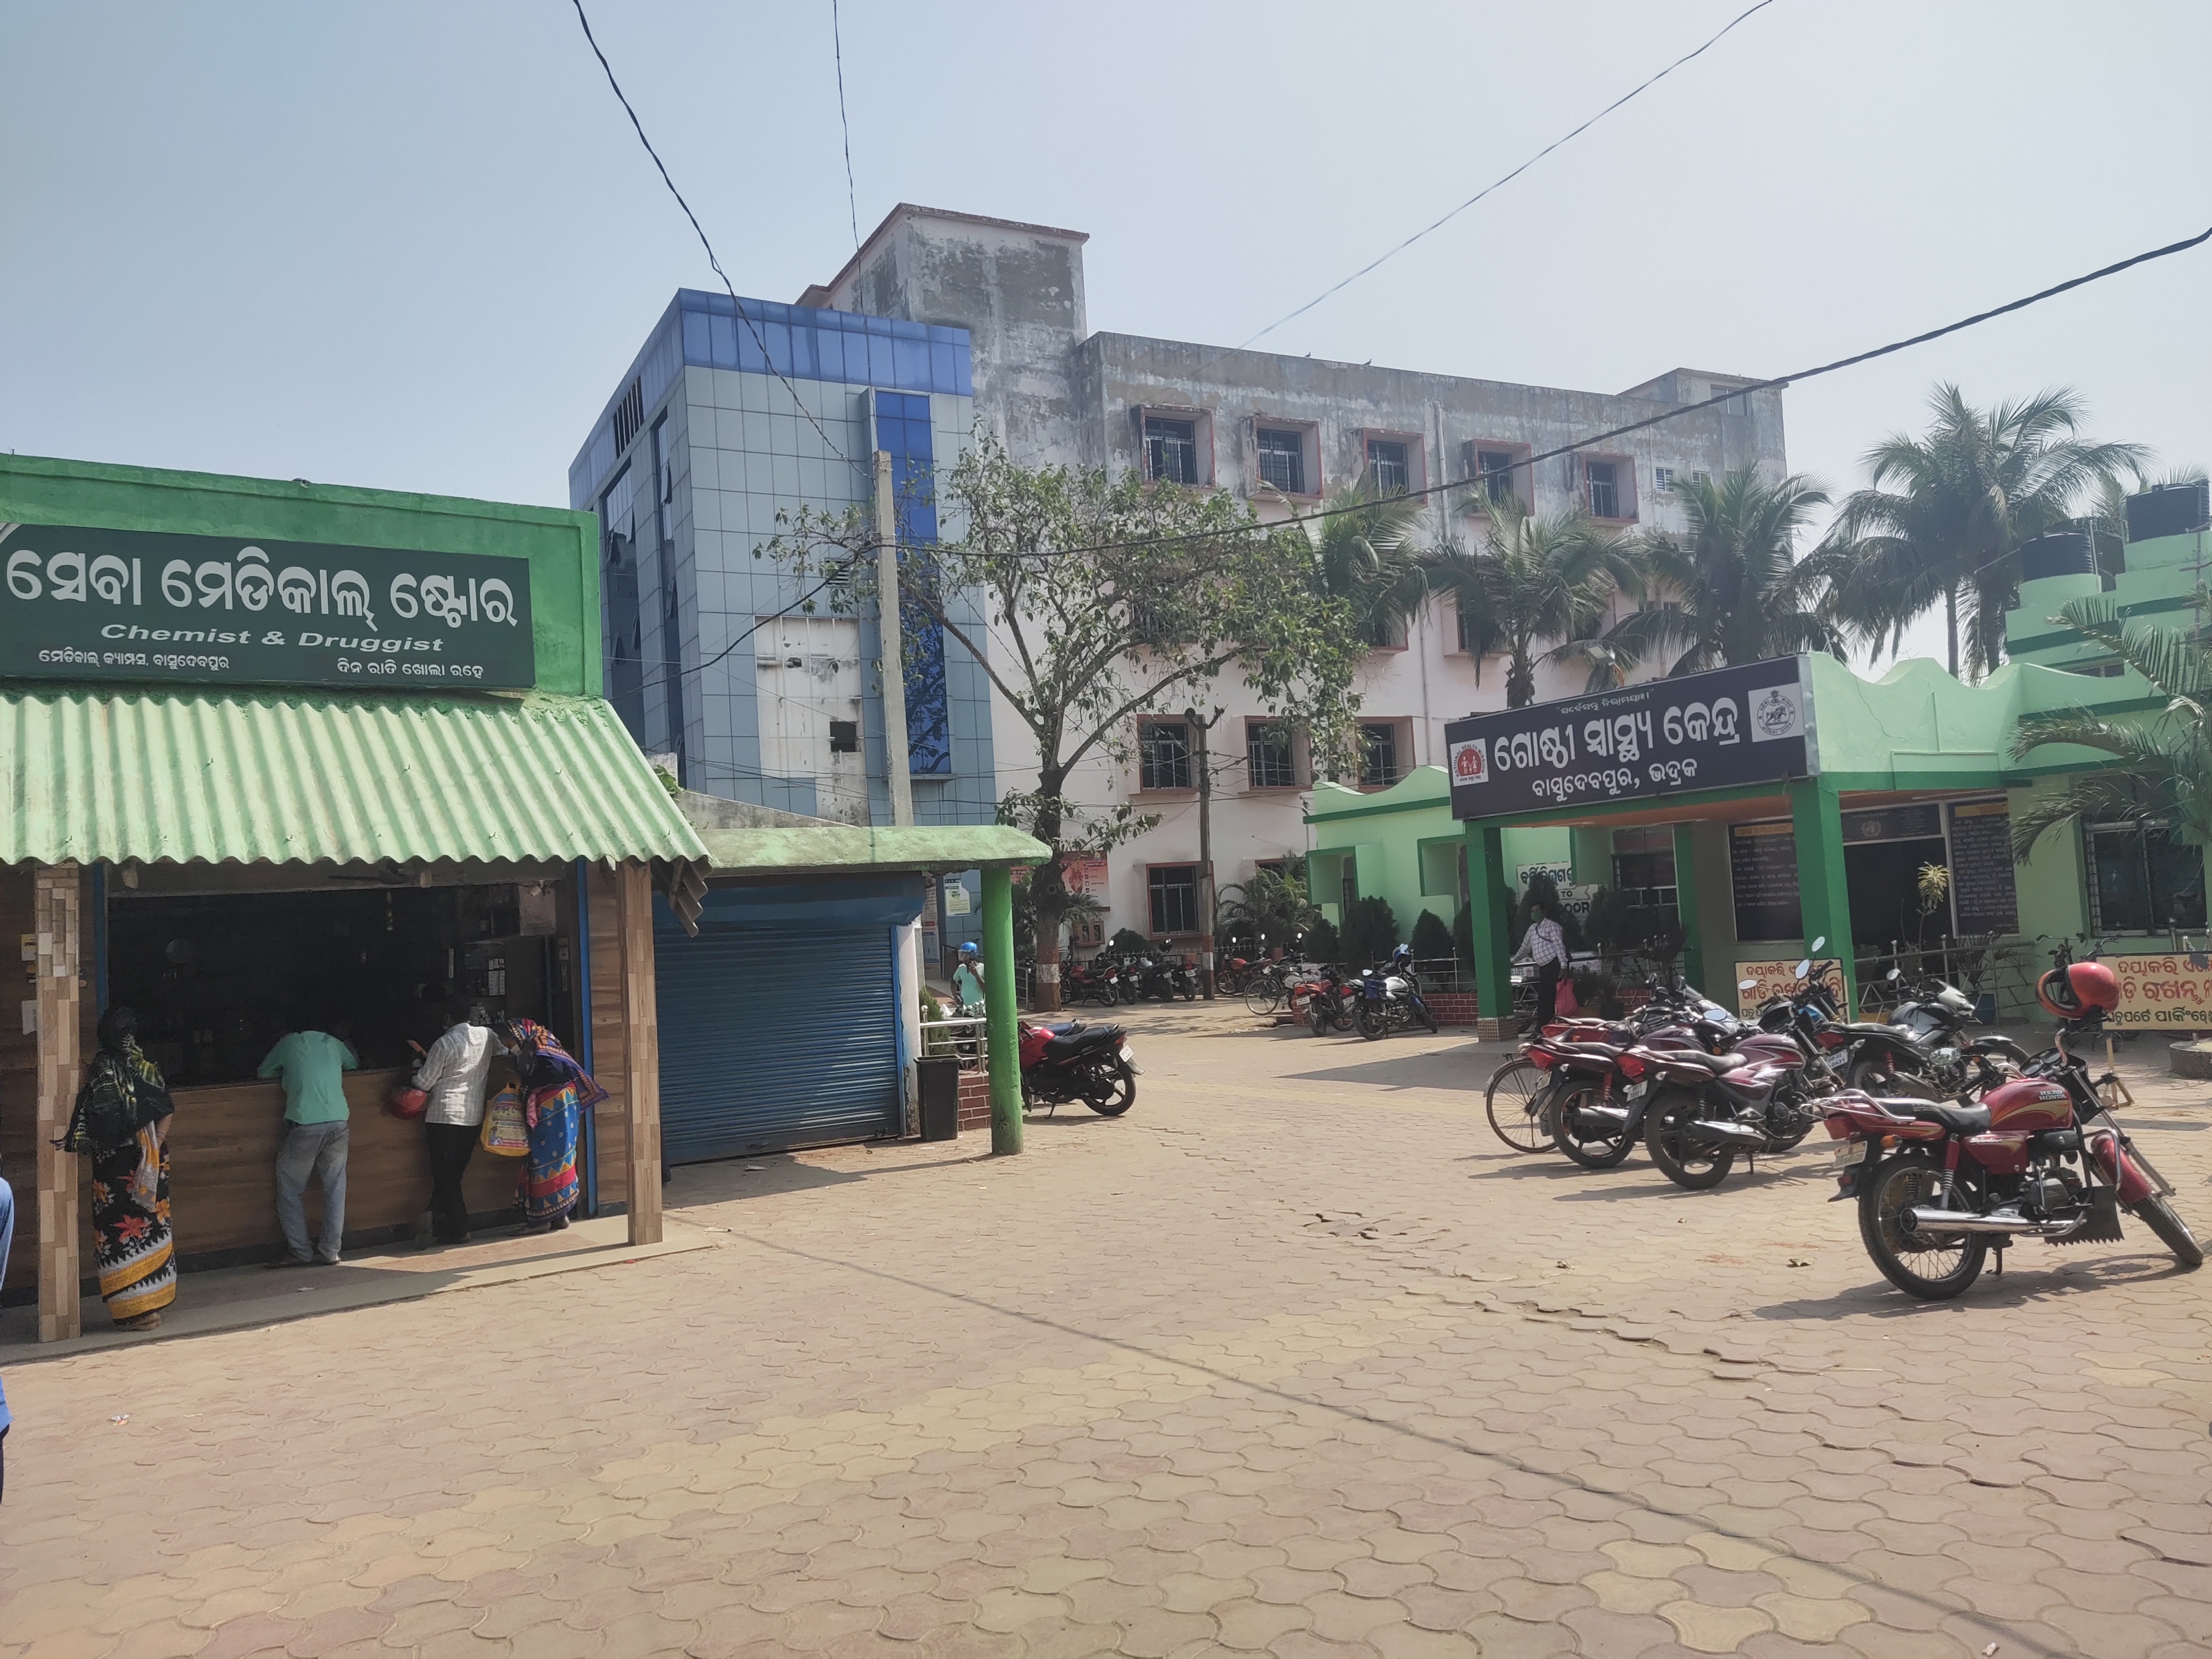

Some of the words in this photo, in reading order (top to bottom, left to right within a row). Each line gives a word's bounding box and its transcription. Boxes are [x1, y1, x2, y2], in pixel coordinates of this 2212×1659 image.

[6, 549, 142, 606] ସେବା
[161, 546, 379, 632] ମେଡିକାଲ୍
[389, 572, 518, 629] ଷ୍ଟୋର
[100, 623, 252, 644] Chemist
[261, 630, 286, 646] &
[298, 632, 445, 654] Druggist
[38, 646, 100, 668] ମେଡିକାଲ୍
[153, 654, 230, 671] ବାସୁଦେବପୁର
[337, 657, 363, 674] ଦିନ
[367, 659, 397, 675] ରାତି
[401, 662, 446, 677] ଖୋଲା
[449, 664, 484, 680] ରହେ
[1494, 724, 1575, 771] ଗୋଷ୍ଠୀ
[1663, 697, 1740, 746] କେନ୍ଦ୍ର
[1453, 749, 1462, 778] NATIONAL
[1478, 748, 1486, 774] MISSION
[1648, 758, 1698, 786] ଭଦ୍ରକ
[1746, 962, 1786, 978] ଦୟାକରି
[2118, 957, 2179, 977] ଦୟାକରି
